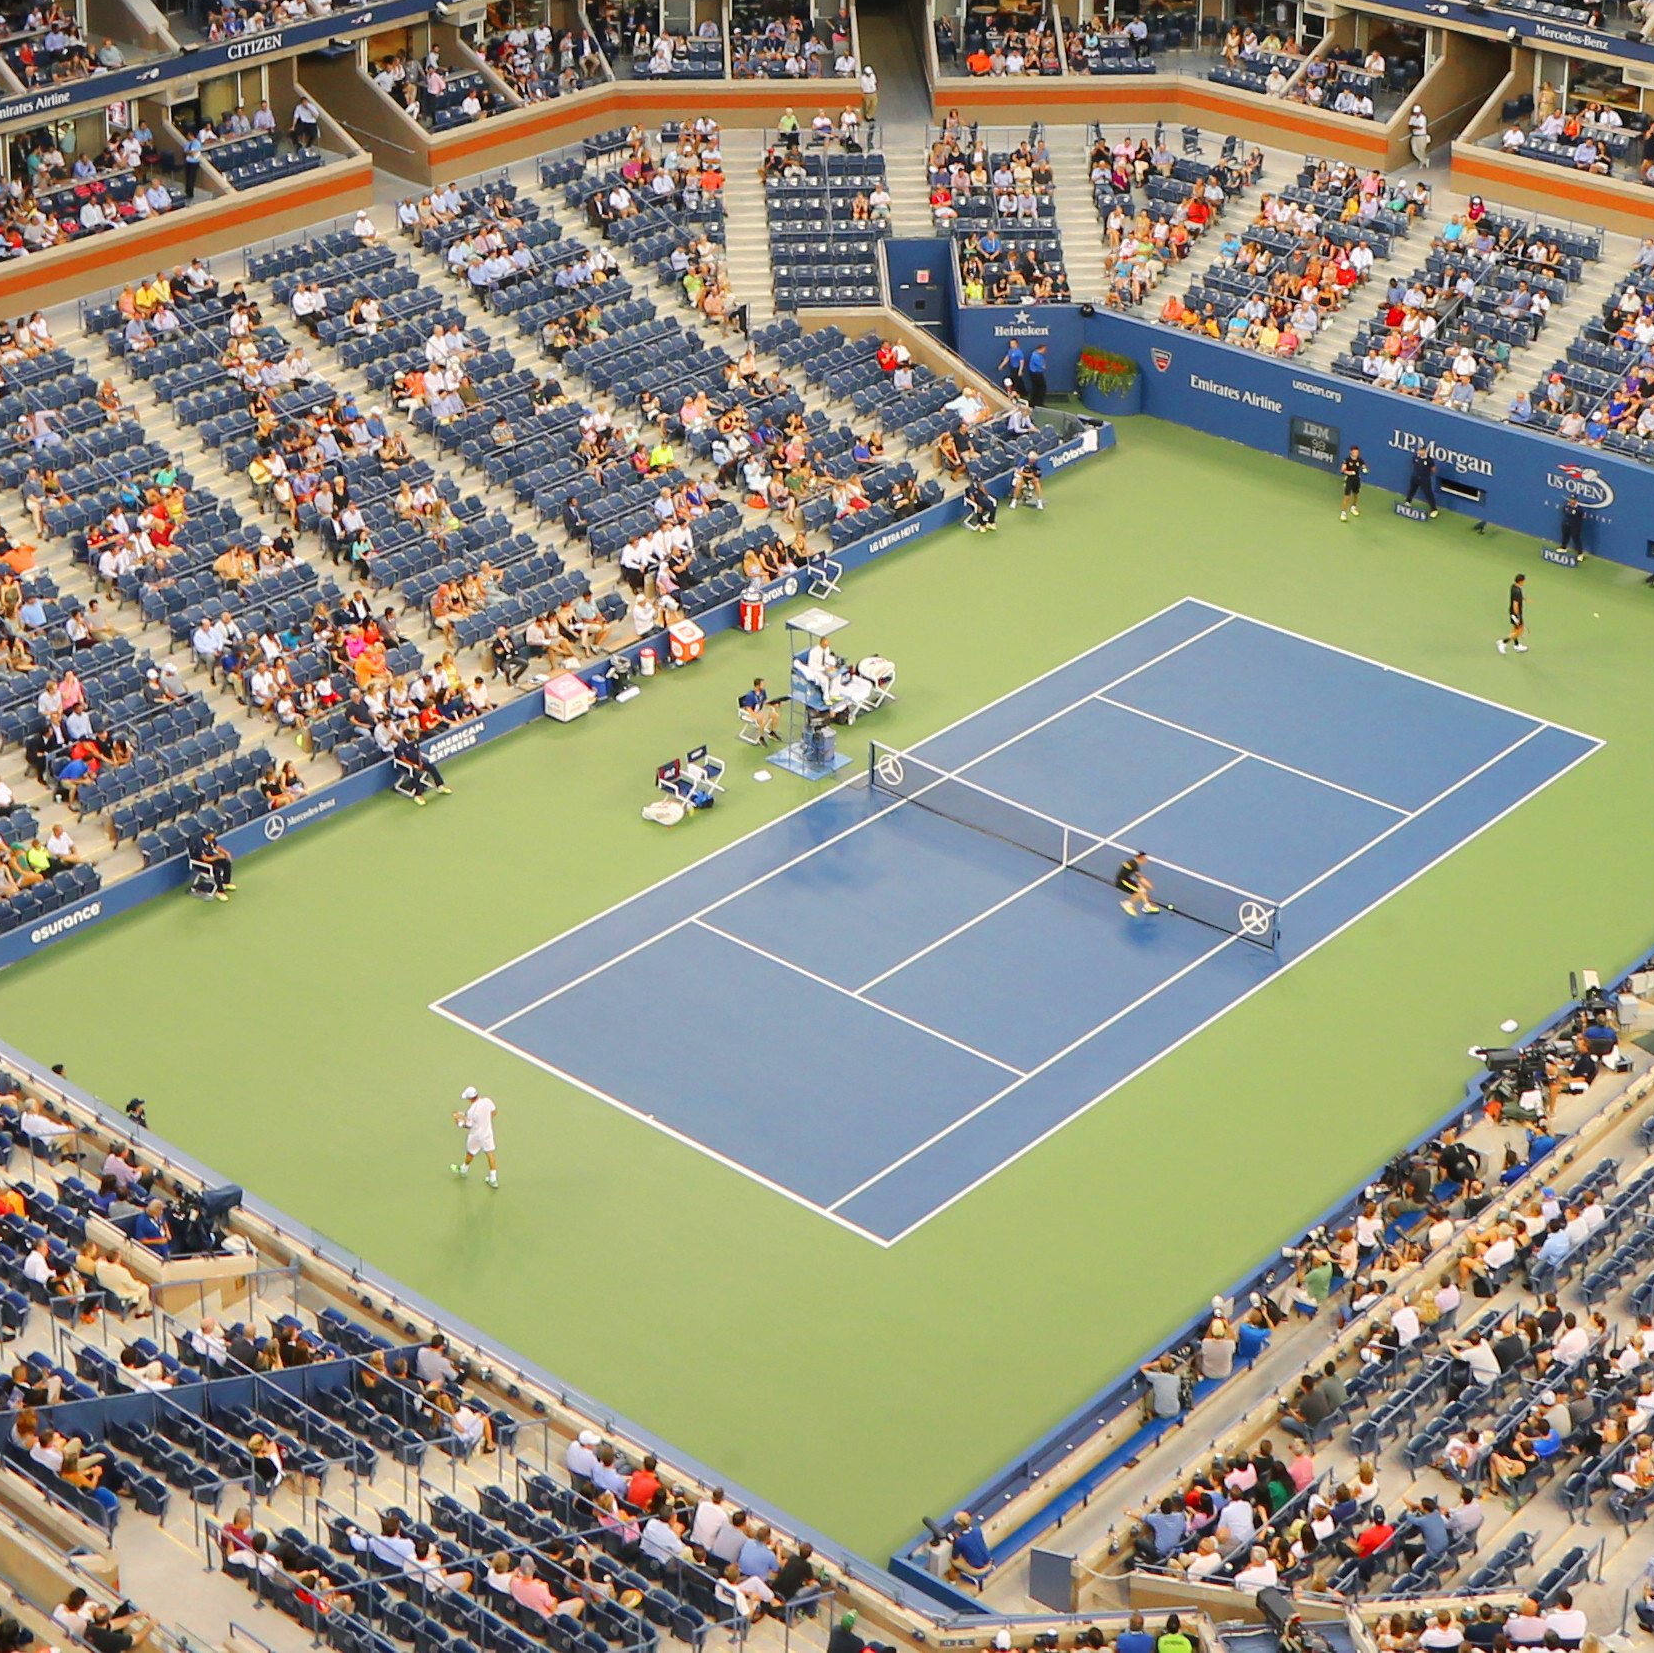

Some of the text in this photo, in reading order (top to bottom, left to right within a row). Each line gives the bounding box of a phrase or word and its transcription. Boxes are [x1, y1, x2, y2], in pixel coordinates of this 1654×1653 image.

[227, 34, 283, 60] CITIZEN
[1534, 24, 1609, 50] Mercedes-Benz
[34, 91, 70, 111] Airline
[994, 325, 1049, 337] Heineken
[1190, 374, 1283, 414] Emirates Airline
[1292, 379, 1342, 403] usopen.org
[1303, 422, 1329, 441] IBM
[1312, 449, 1333, 463] MPH
[1388, 429, 1494, 477] J.P.Morgan
[1547, 473, 1603, 501] US OPEN
[1397, 504, 1419, 519] POLO
[900, 521, 921, 539] HDTV
[1544, 550, 1567, 564] POLO
[429, 735, 477, 763] EXPRESS
[430, 722, 485, 753] AMERICAN
[286, 798, 336, 827] Mercedes-Benz
[31, 902, 101, 944] esurance
